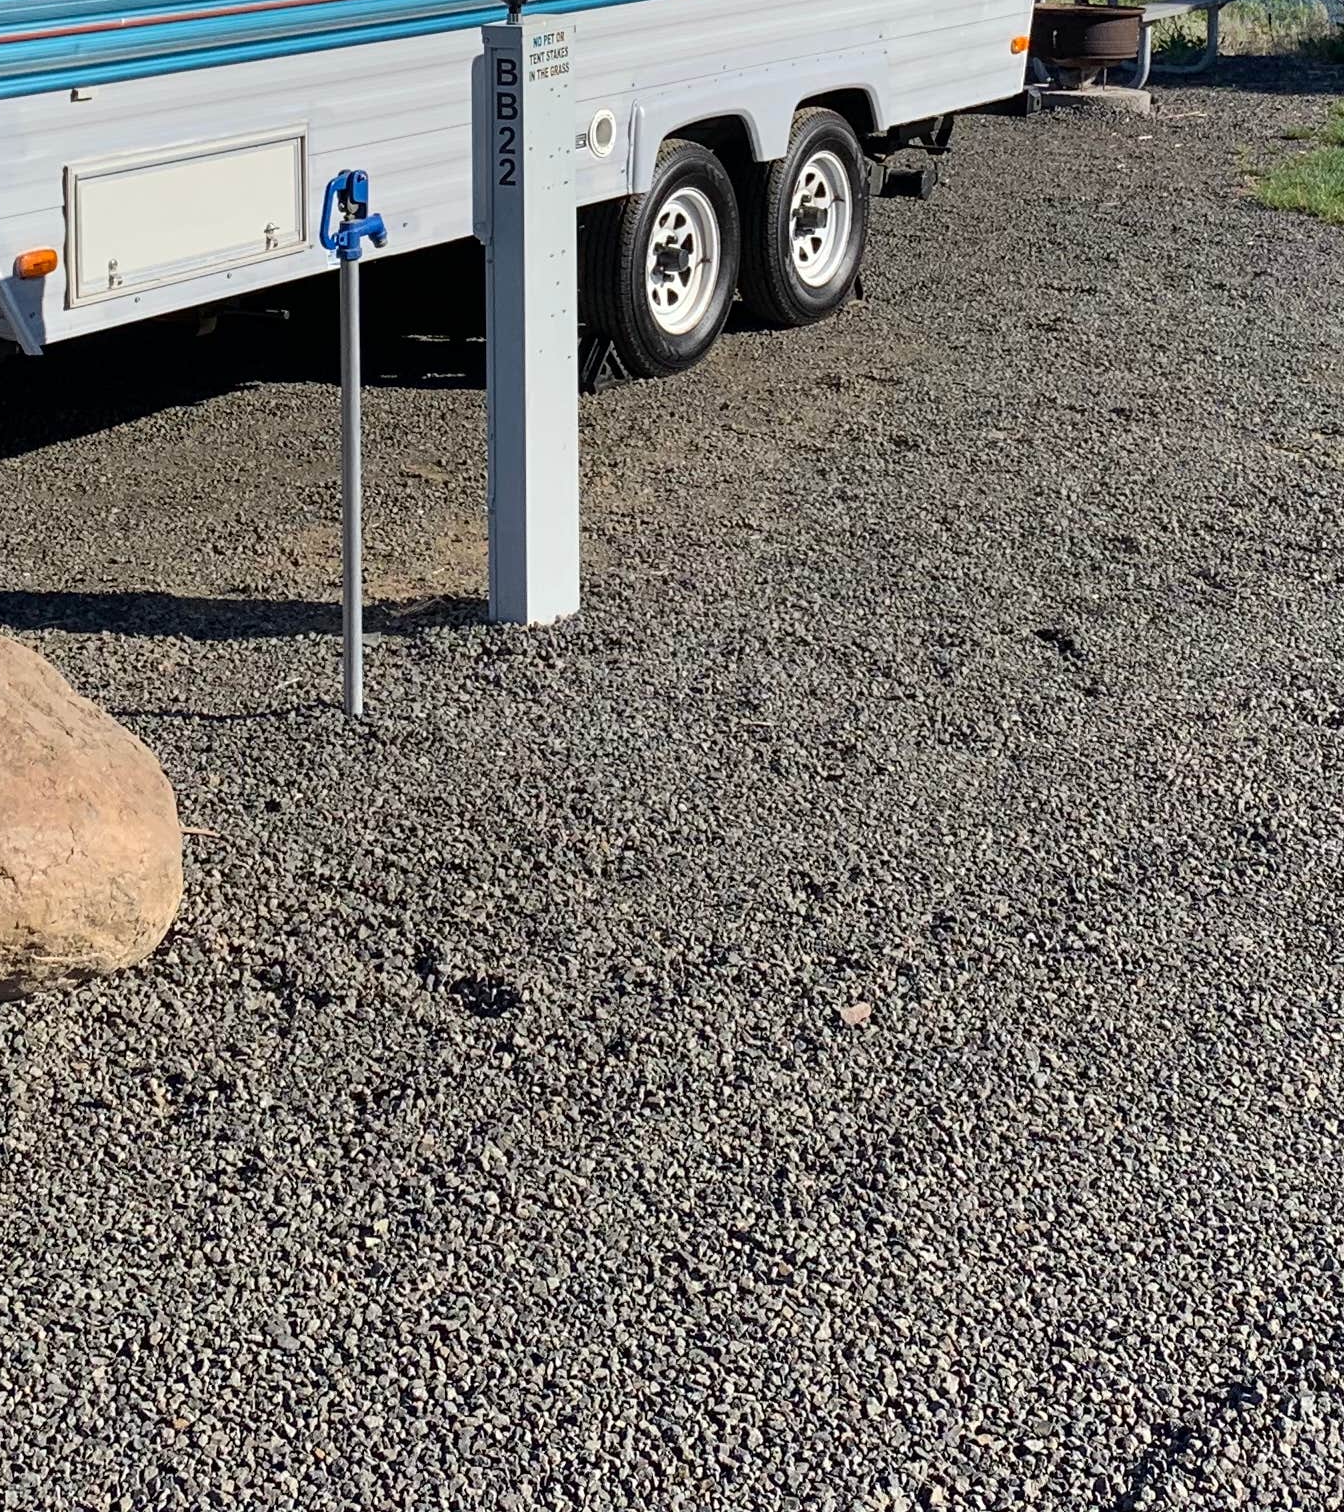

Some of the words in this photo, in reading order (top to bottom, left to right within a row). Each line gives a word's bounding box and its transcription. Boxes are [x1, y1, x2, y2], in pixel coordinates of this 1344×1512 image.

[533, 36, 542, 47] NO
[543, 33, 554, 45] PET
[556, 31, 564, 42] OR
[529, 52, 545, 65] TENT
[546, 47, 569, 62] STAKES
[529, 71, 536, 81] IN
[537, 67, 549, 80] THE
[550, 62, 569, 76] GRASS
[496, 58, 518, 186] BB22
